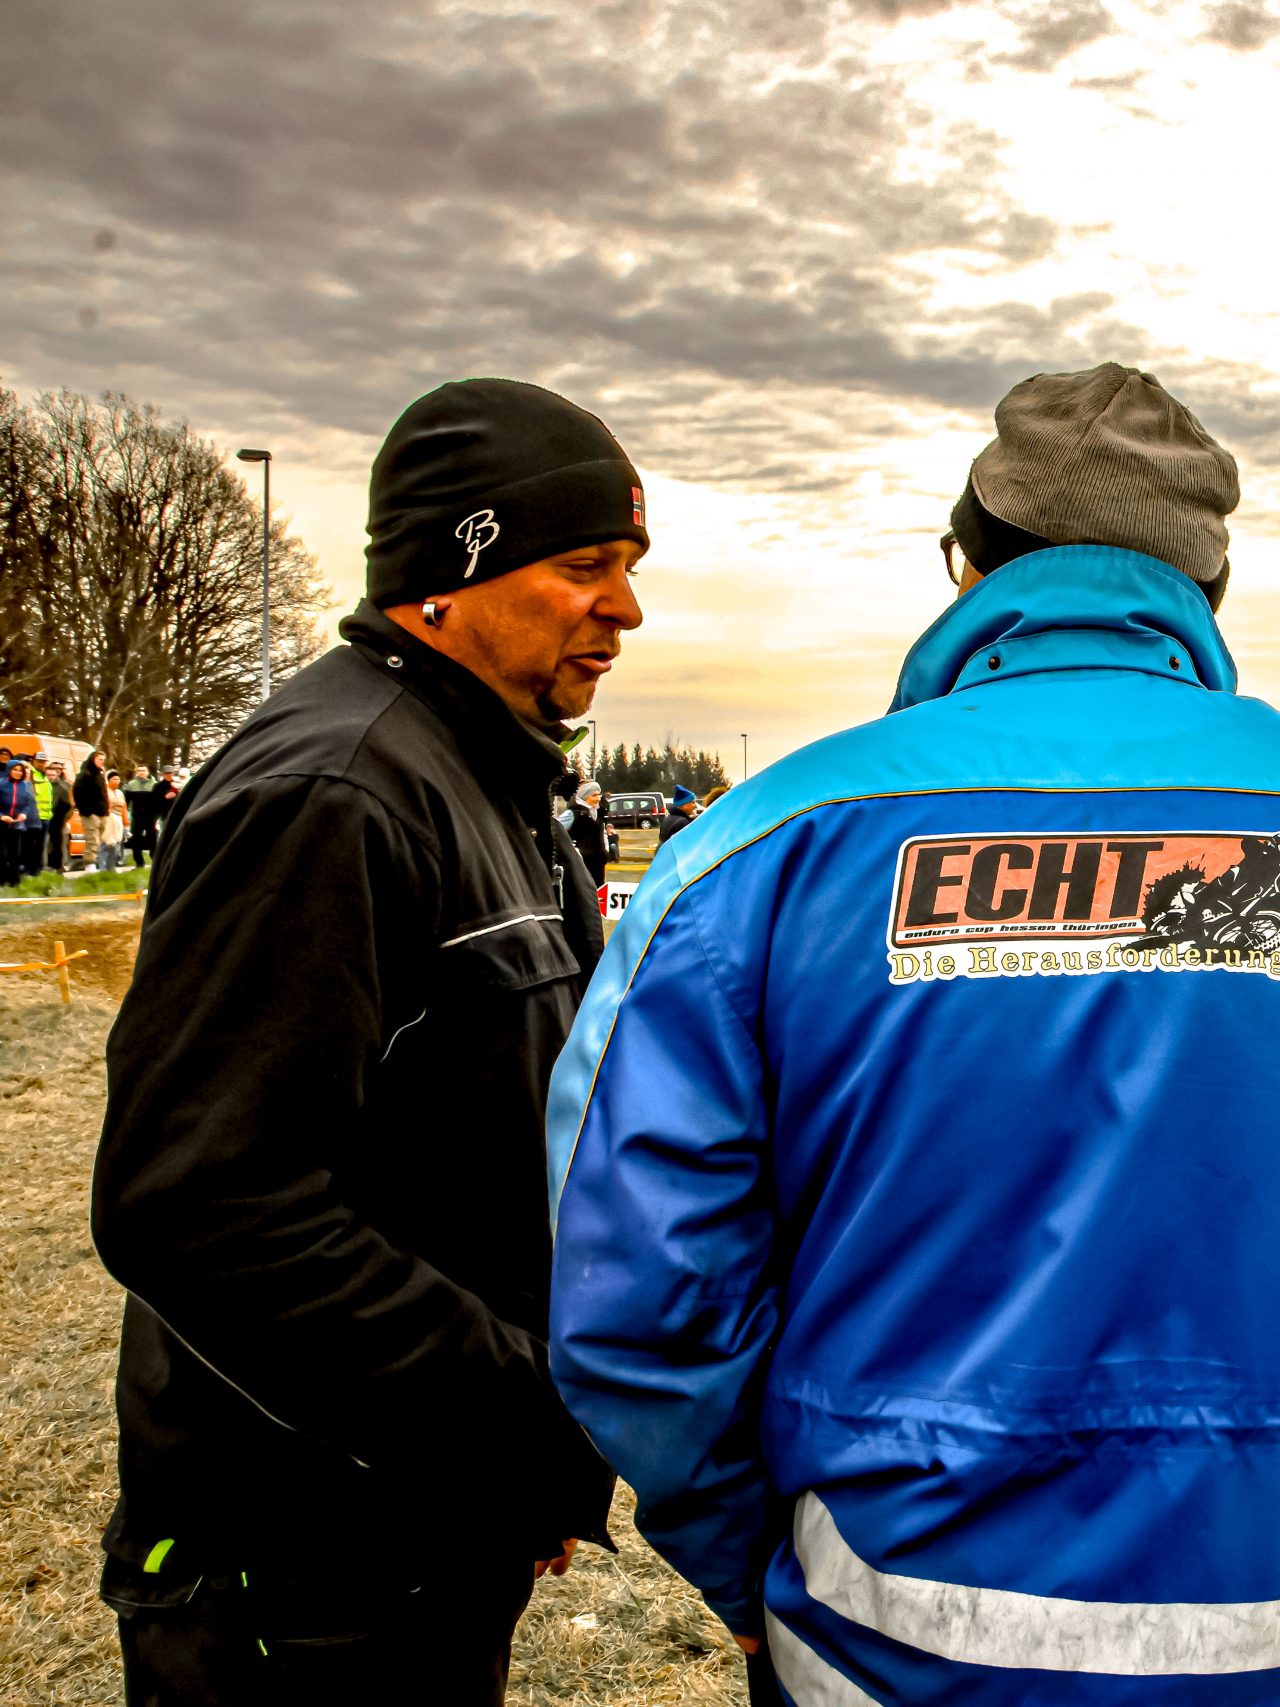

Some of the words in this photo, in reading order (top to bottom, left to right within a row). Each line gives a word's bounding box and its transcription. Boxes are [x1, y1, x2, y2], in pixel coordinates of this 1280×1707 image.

[904, 840, 1166, 927] ECHT
[904, 927, 960, 939] enduro
[965, 925, 994, 934] cup
[1000, 923, 1057, 932] hessen
[1062, 920, 1138, 932] thüringen
[891, 950, 956, 980] Die
